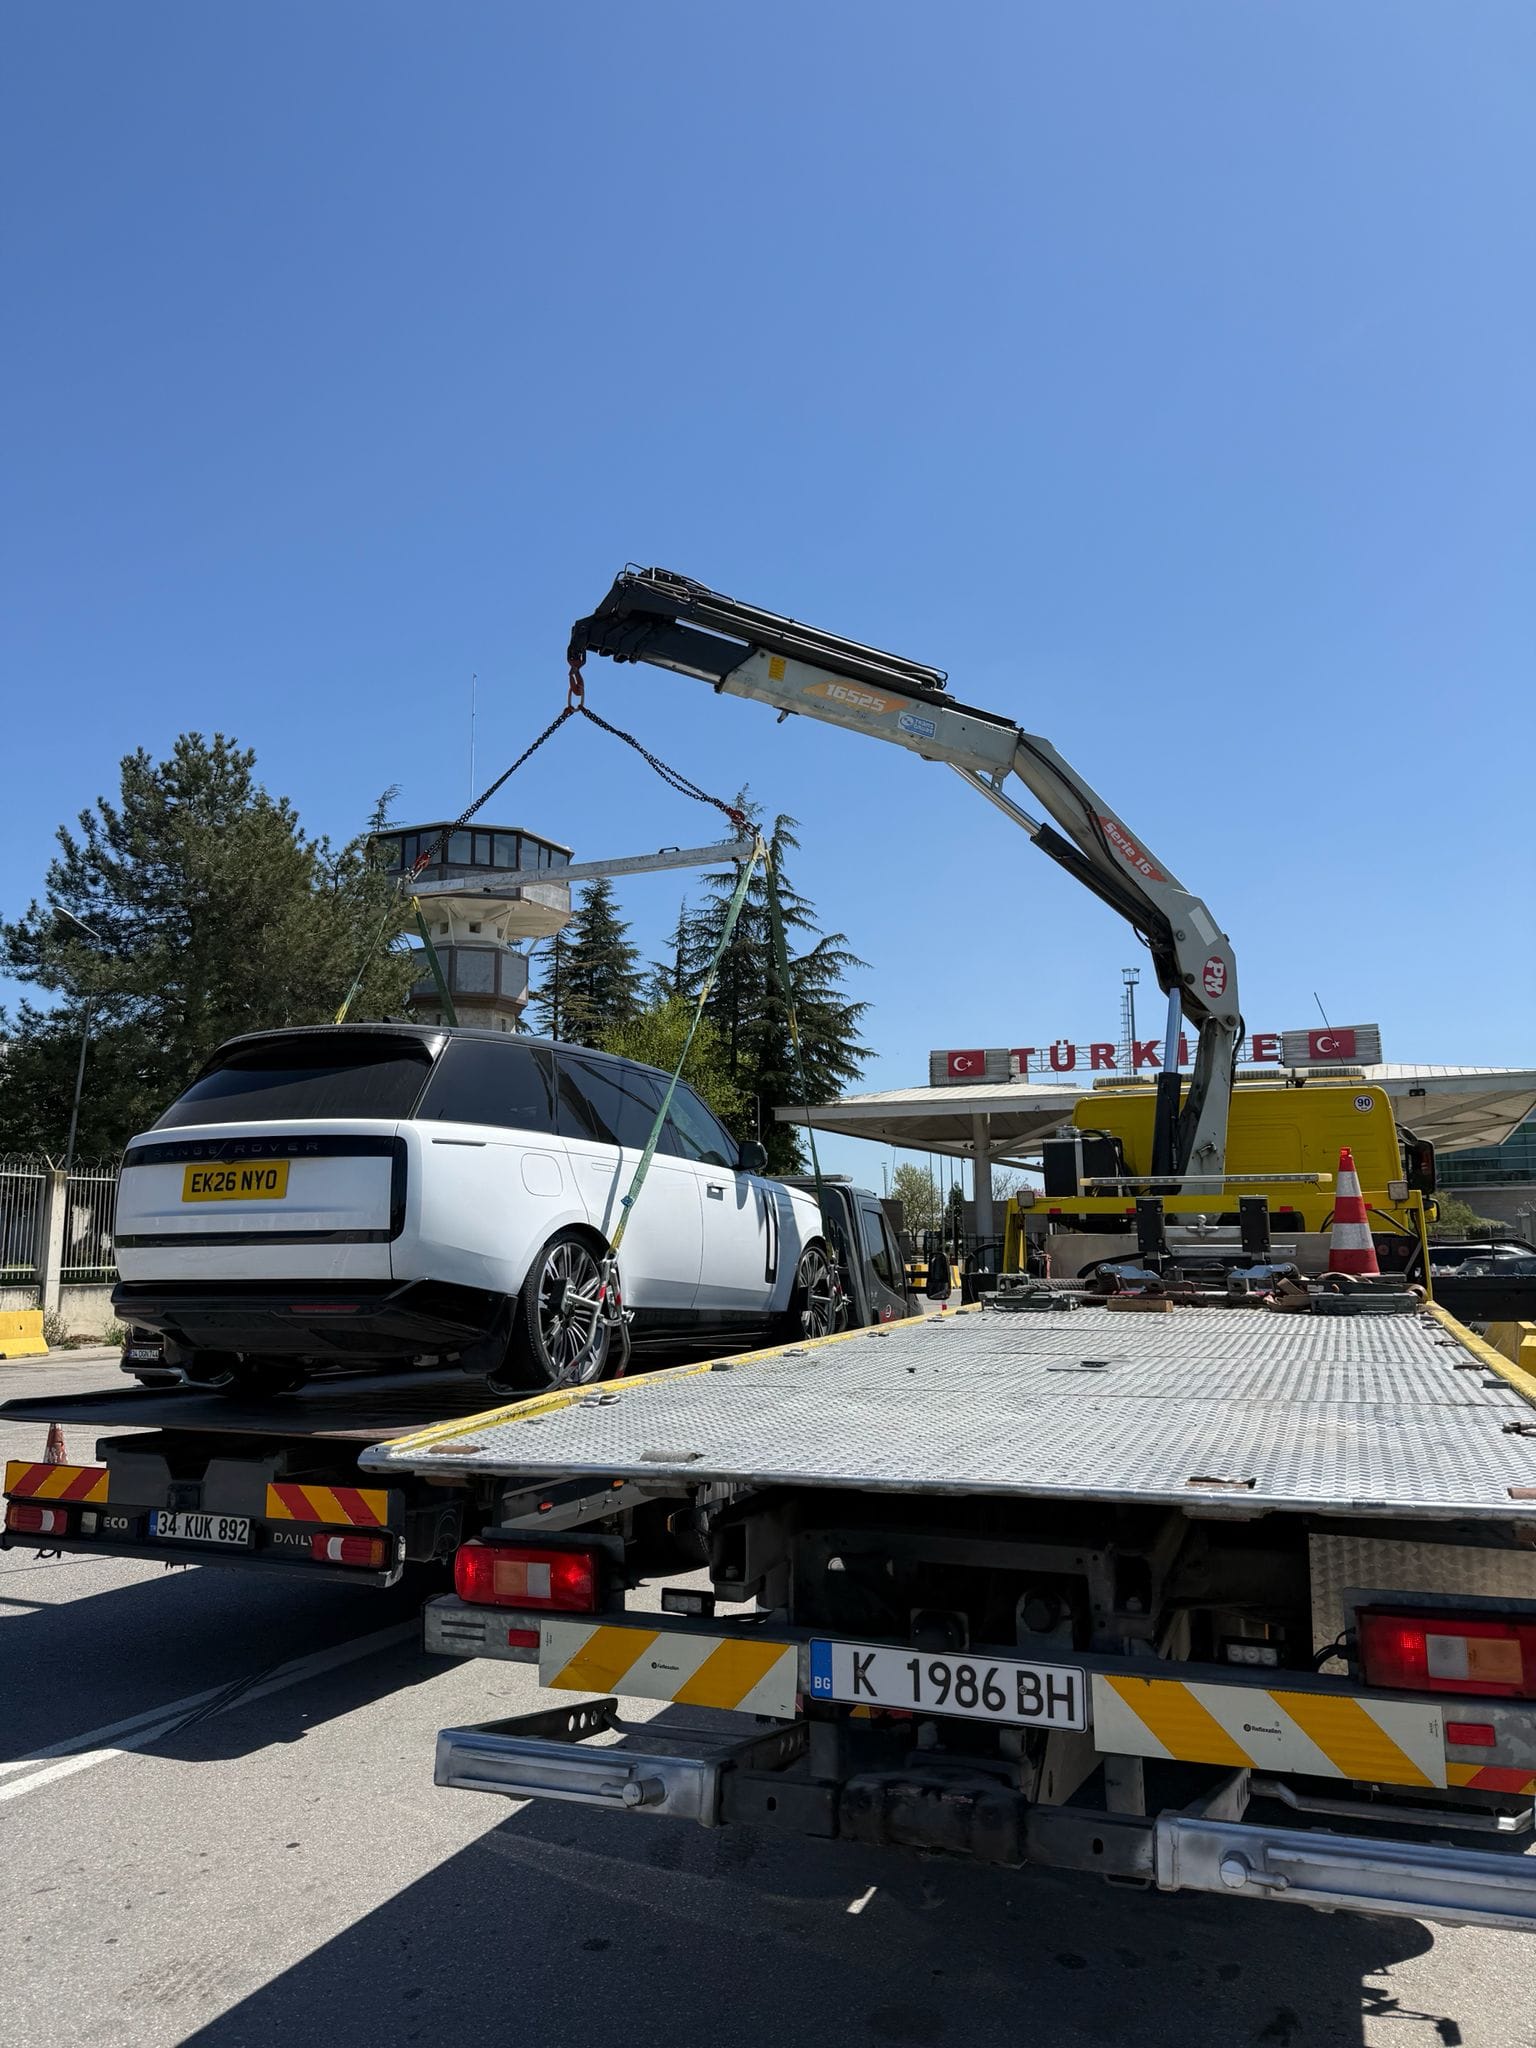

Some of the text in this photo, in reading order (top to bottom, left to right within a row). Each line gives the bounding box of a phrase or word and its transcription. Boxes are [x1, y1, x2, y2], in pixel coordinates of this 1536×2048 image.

[826, 684, 887, 712] 16525
[1104, 822, 1154, 875] Serie 16
[1205, 960, 1225, 996] PM
[1010, 1032, 1280, 1074] TÜRKİE
[1357, 1098, 1371, 1107] 90
[154, 1142, 320, 1158] RANGE ROVER
[191, 1169, 277, 1193] EK26 NYO
[103, 1516, 129, 1529] ECO
[159, 1513, 248, 1542] 34 KUK 892
[814, 1676, 831, 1690] BG
[853, 1652, 1075, 1721] K 1986 BH
